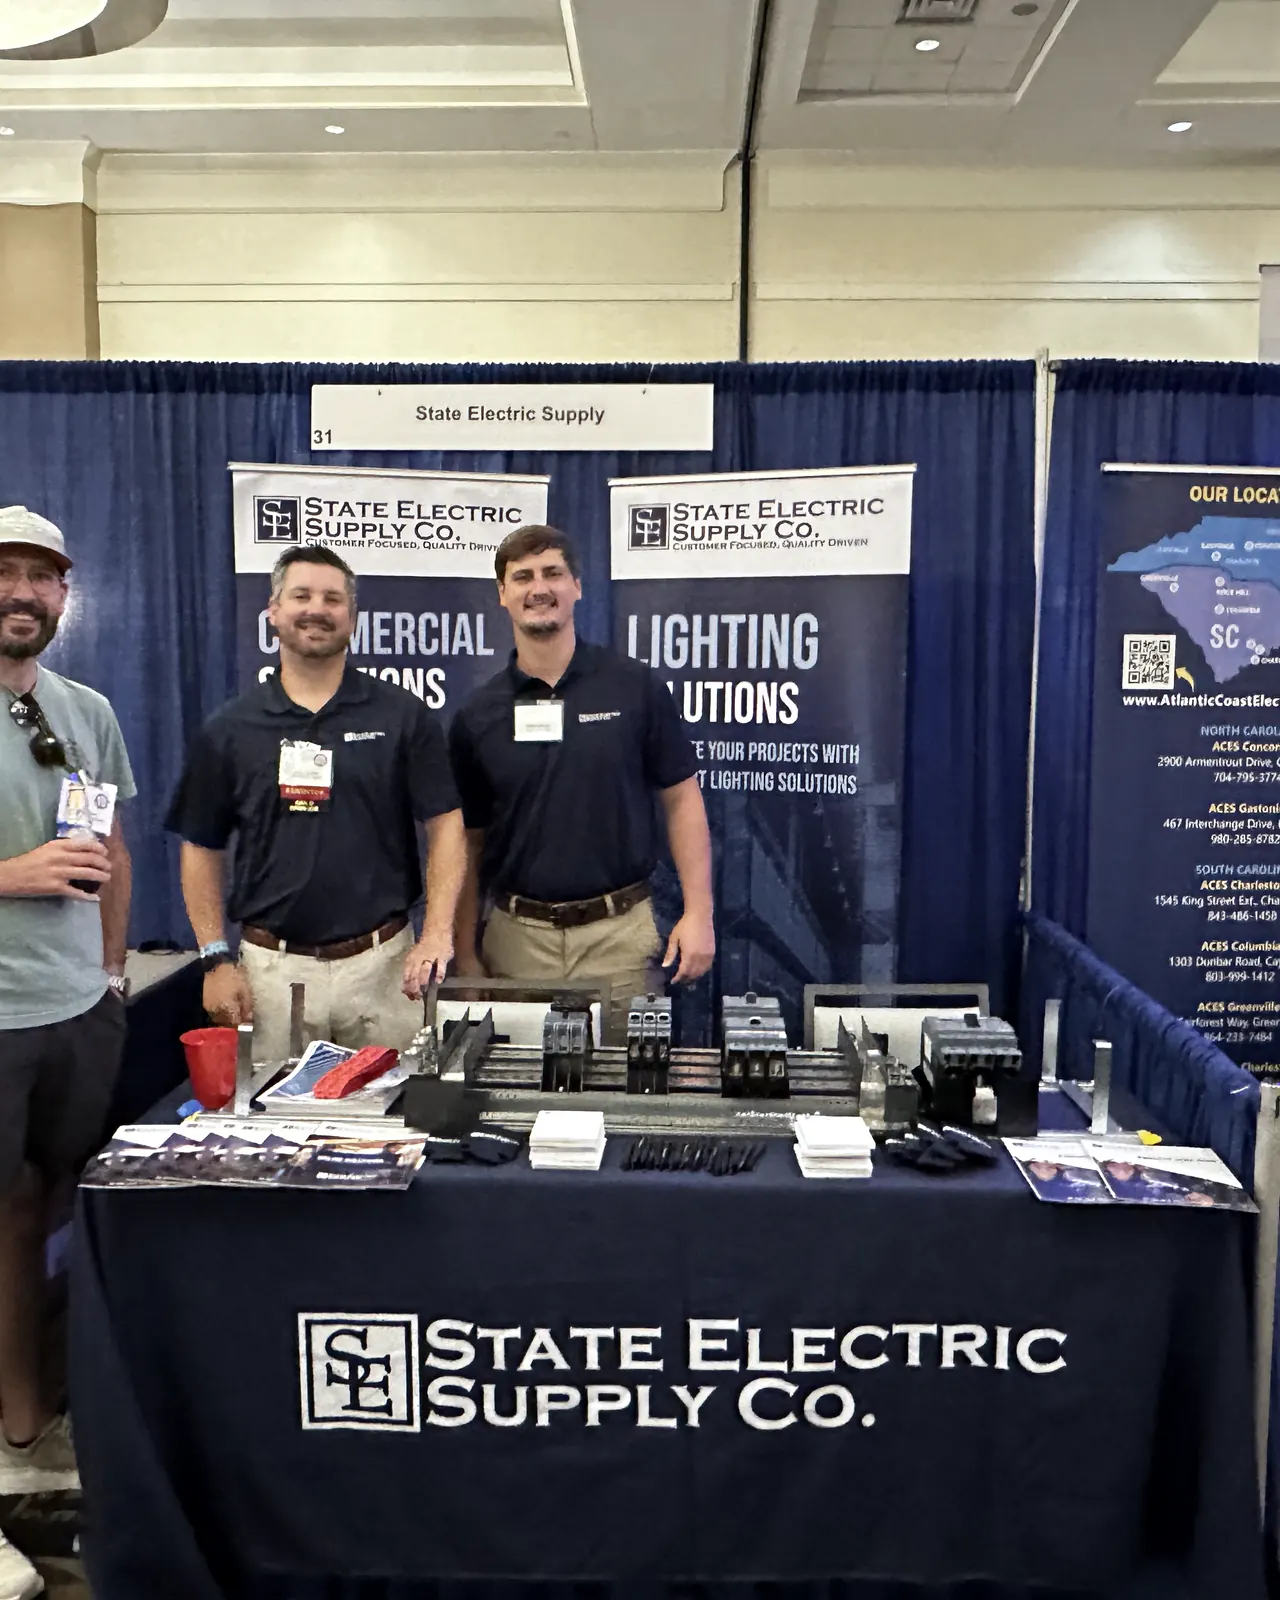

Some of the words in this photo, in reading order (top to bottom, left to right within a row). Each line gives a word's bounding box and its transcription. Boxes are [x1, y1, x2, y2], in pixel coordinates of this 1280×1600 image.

[416, 406, 461, 421] State
[468, 406, 535, 421] Electric
[542, 406, 605, 425] Supply
[313, 429, 332, 444] 31
[1189, 485, 1228, 502] OUR
[1233, 486, 1280, 504] LOCA
[305, 497, 388, 519] STATE
[397, 500, 522, 524] ELECTRIC
[673, 503, 750, 521] STATE
[758, 498, 885, 519] ELECTRIC
[305, 518, 406, 540] SUPPLY
[414, 522, 461, 541] CO.
[673, 523, 767, 542] SUPPLY
[774, 520, 820, 540] CO.
[423, 541, 466, 551] QUALITY
[828, 538, 869, 548] DRIVEN
[258, 610, 495, 656] CMERCIAL
[1210, 623, 1240, 649] SC
[628, 613, 819, 670] LIGHTING
[1200, 725, 1240, 737] NORTH
[708, 741, 745, 762] YOUR
[748, 742, 819, 764] PROJECTS
[822, 743, 860, 765] WITH
[1212, 741, 1239, 752] ACES
[1158, 756, 1183, 767] 2900
[711, 771, 773, 791] LIGHTING
[778, 772, 857, 795] SOLUTIONS
[1208, 803, 1236, 814] ACES
[1239, 803, 1280, 814] Gastoni
[1163, 818, 1182, 829] 467
[1185, 818, 1244, 831] Interchange
[1196, 864, 1233, 875] SOUTH
[1200, 880, 1227, 891] ACES
[1155, 895, 1178, 906] 1545
[1181, 895, 1204, 908] King
[1206, 895, 1236, 906] Street
[1201, 940, 1229, 952] ACES
[1169, 956, 1193, 967] 1303
[1197, 1002, 1225, 1012] ACES
[425, 1318, 664, 1372] STATE
[687, 1317, 1068, 1374] ELECTRIC
[425, 1376, 716, 1429] SUPPLY
[737, 1376, 877, 1431] CO.
